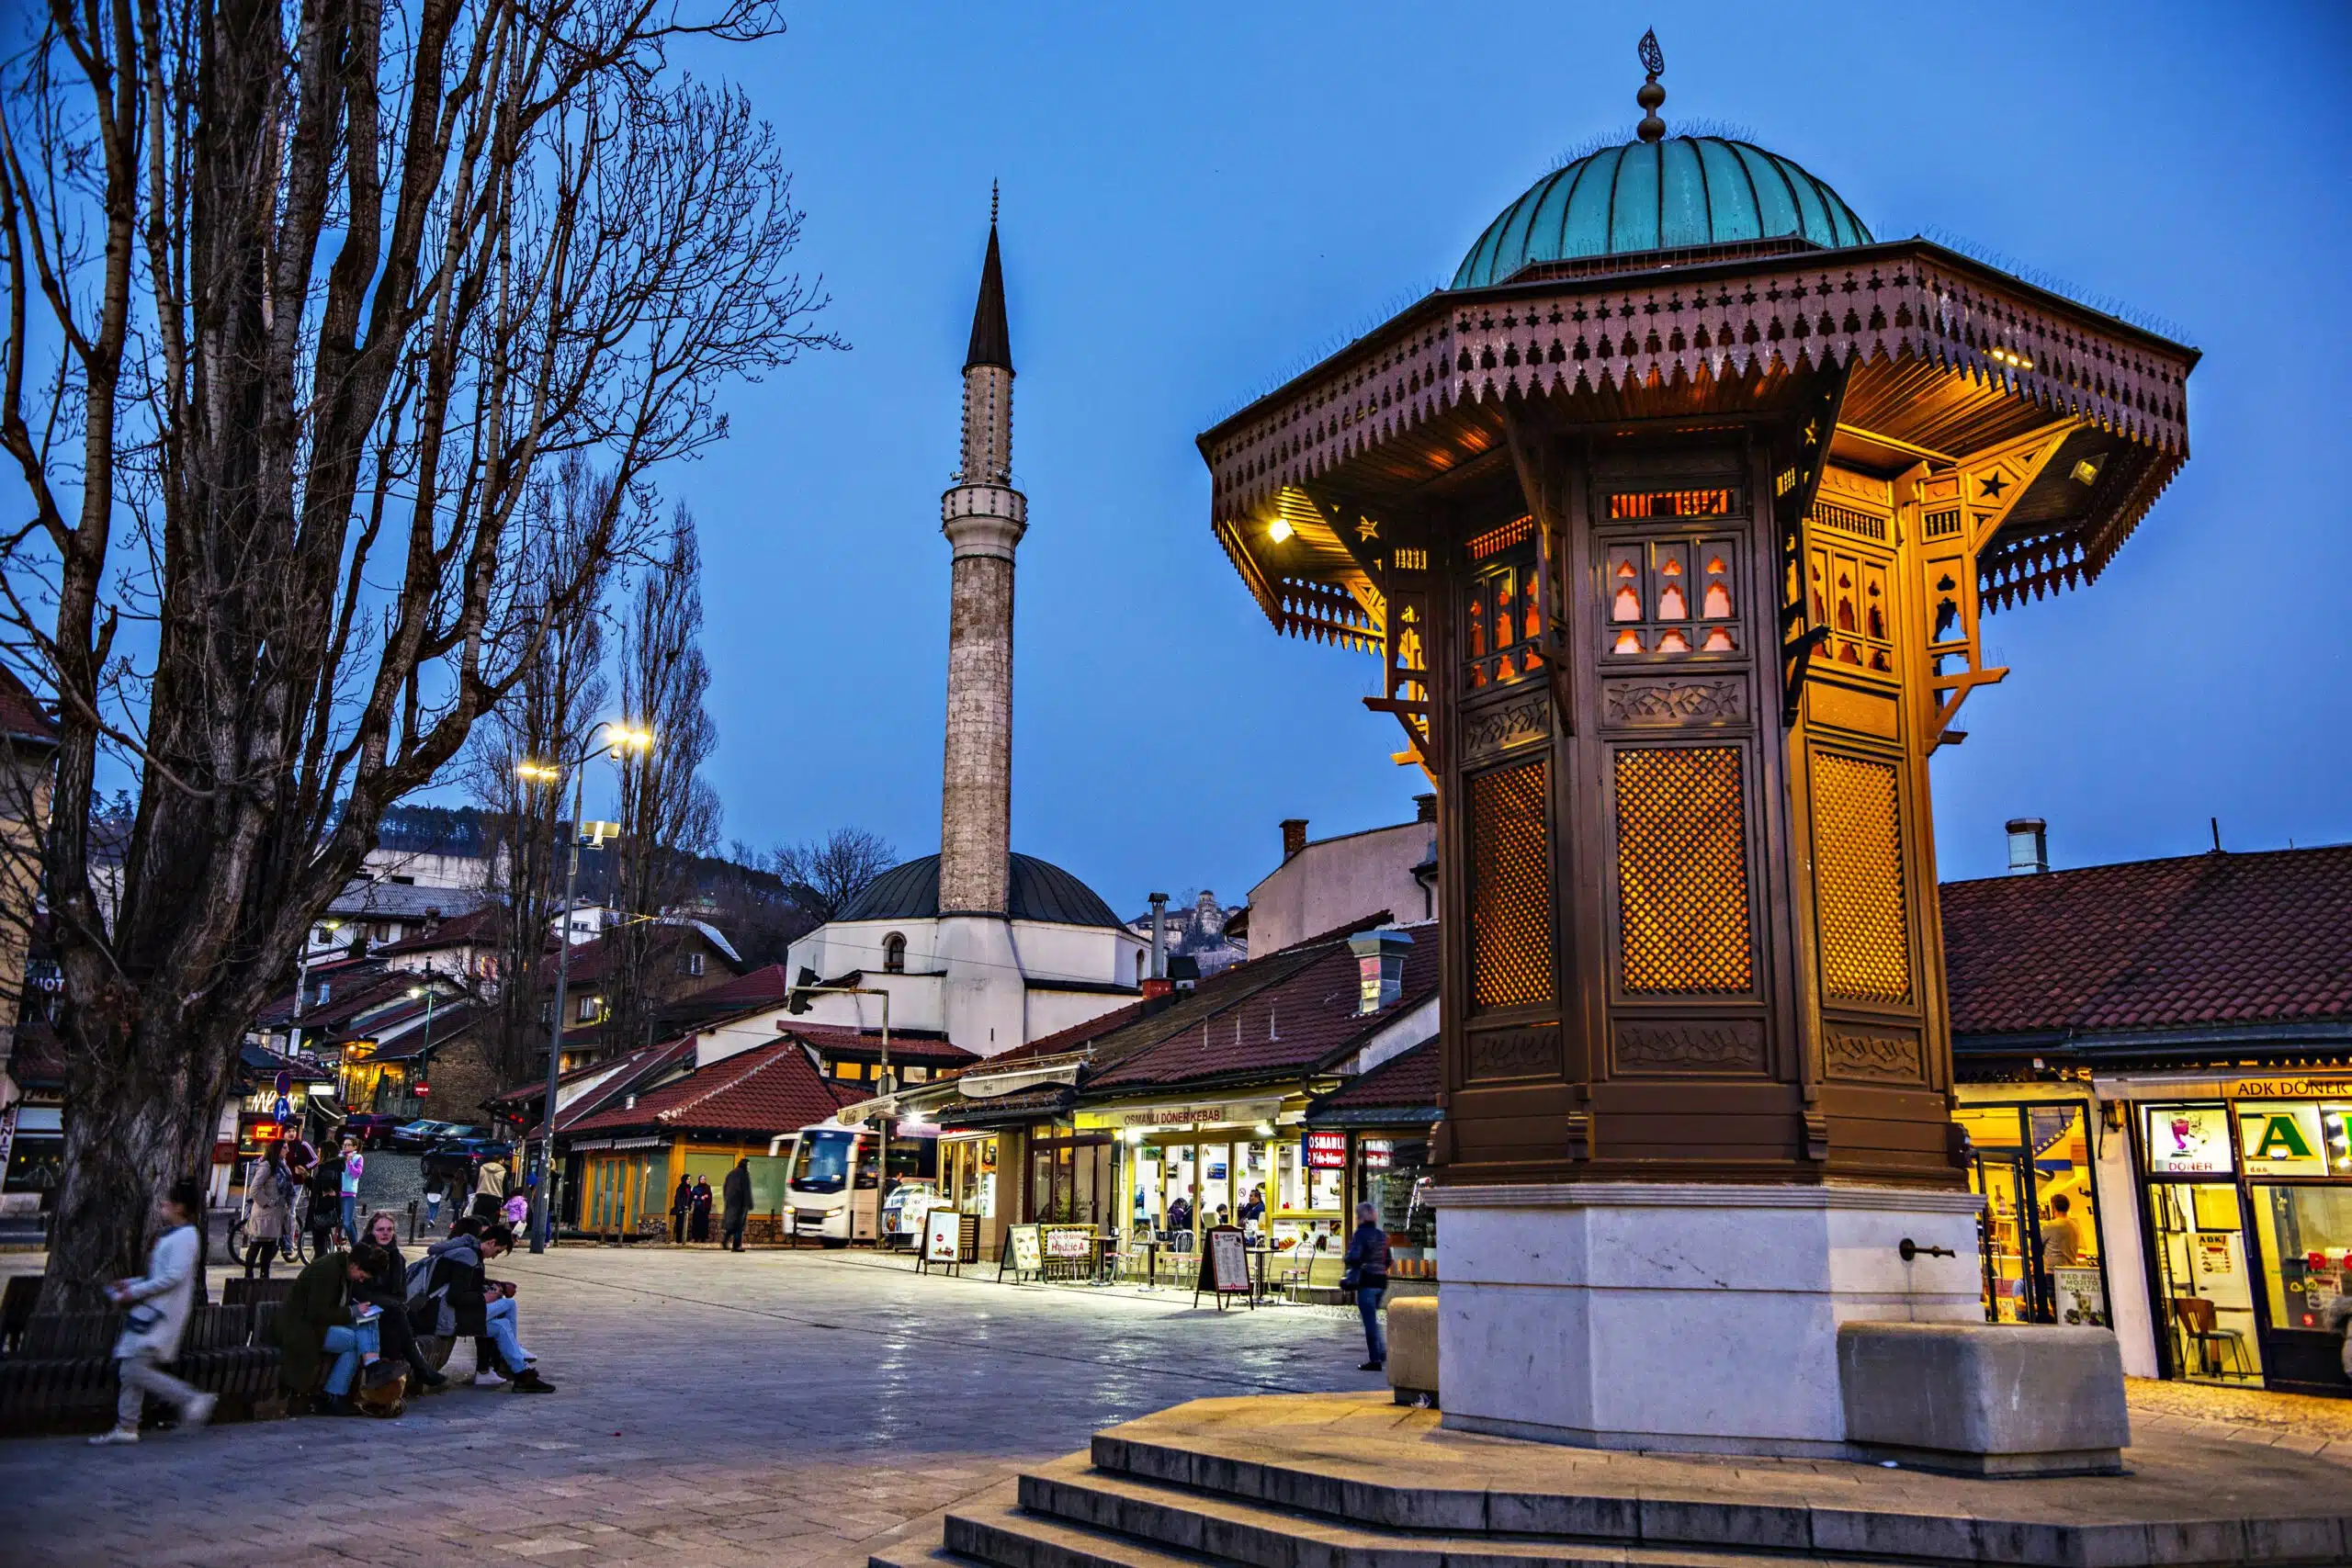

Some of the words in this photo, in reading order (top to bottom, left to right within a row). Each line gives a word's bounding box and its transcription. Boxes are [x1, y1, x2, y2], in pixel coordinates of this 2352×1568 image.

[2238, 1083, 2275, 1095] ADK
[2280, 1080, 2347, 1095] DÖNER
[1125, 1113, 1159, 1125] OSMANLI
[1160, 1110, 1188, 1124] DÖNER
[1190, 1110, 1220, 1122] KEBAB
[1309, 1136, 1344, 1149] OSMANLI
[2251, 1112, 2316, 1159] A
